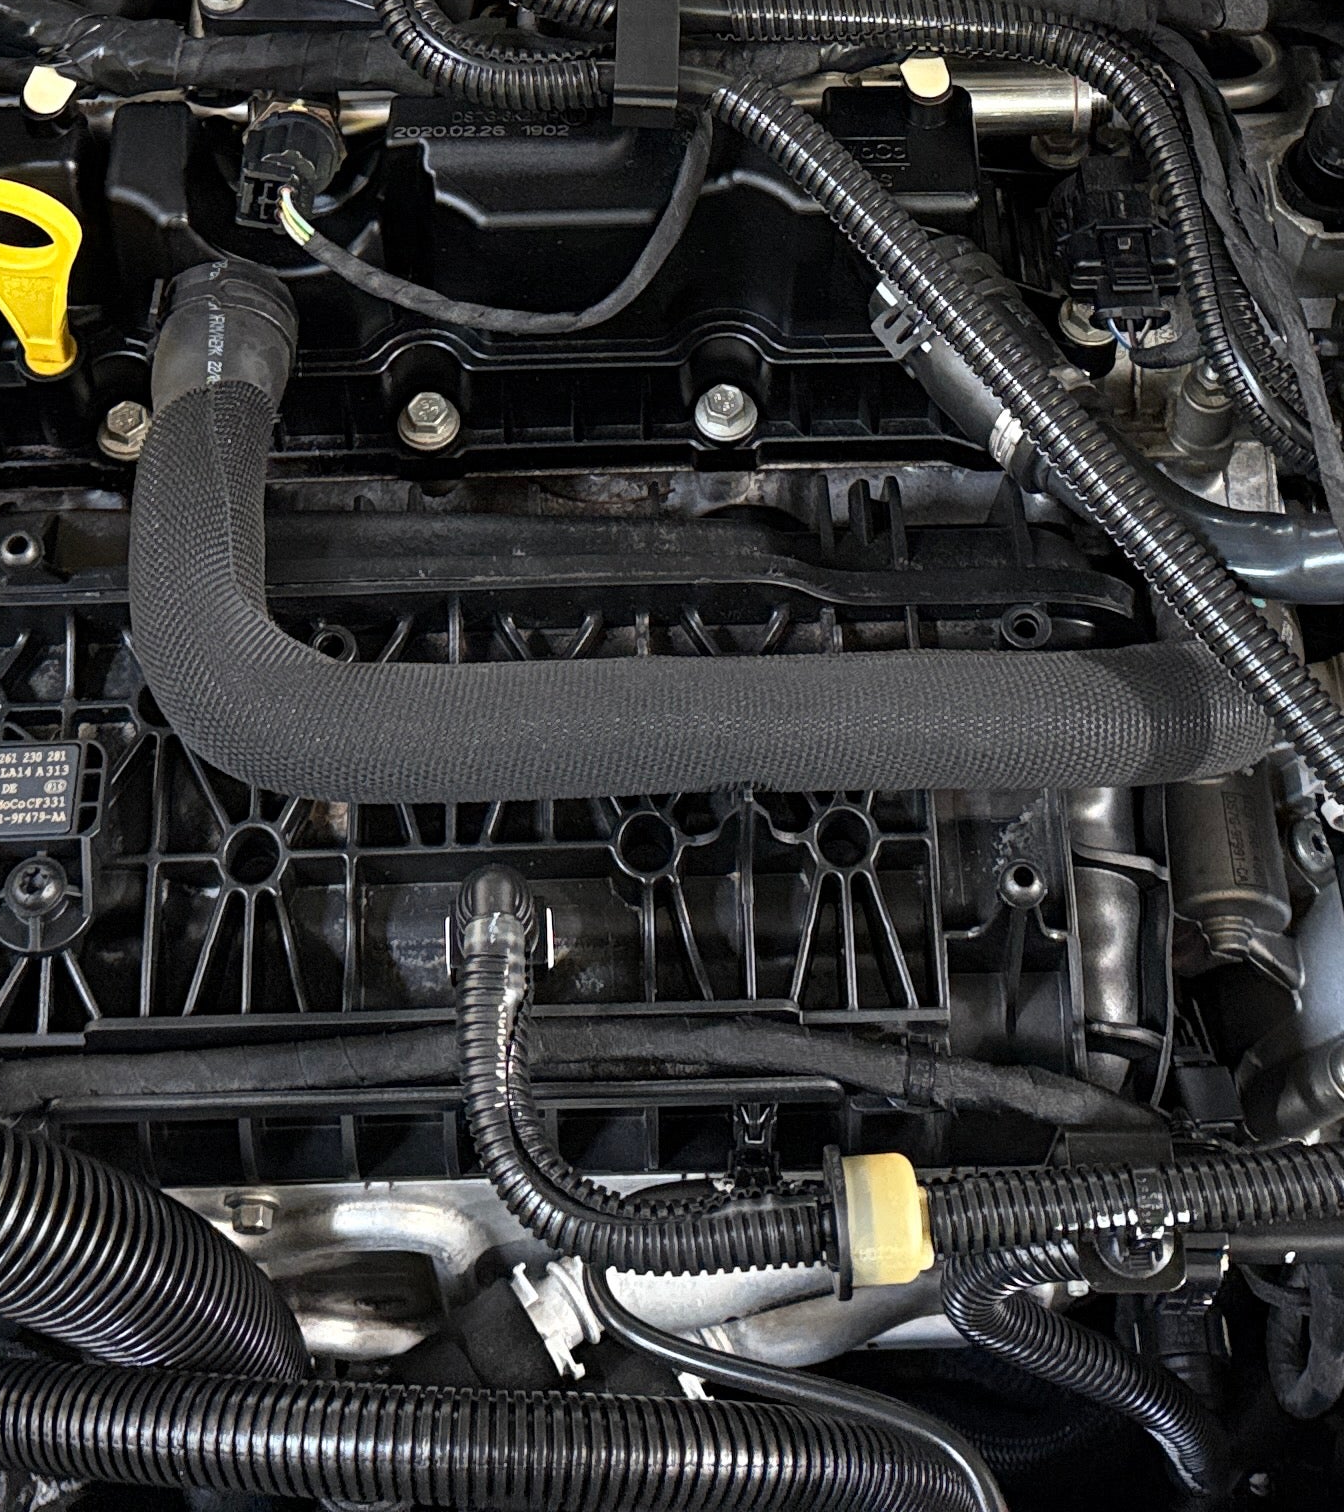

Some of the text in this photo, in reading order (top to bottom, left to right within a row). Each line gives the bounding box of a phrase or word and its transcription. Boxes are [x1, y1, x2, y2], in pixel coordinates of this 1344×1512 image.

[393, 124, 570, 138] 2020.02.26 1902
[22, 752, 43, 764] 230
[1, 783, 18, 795] DE
